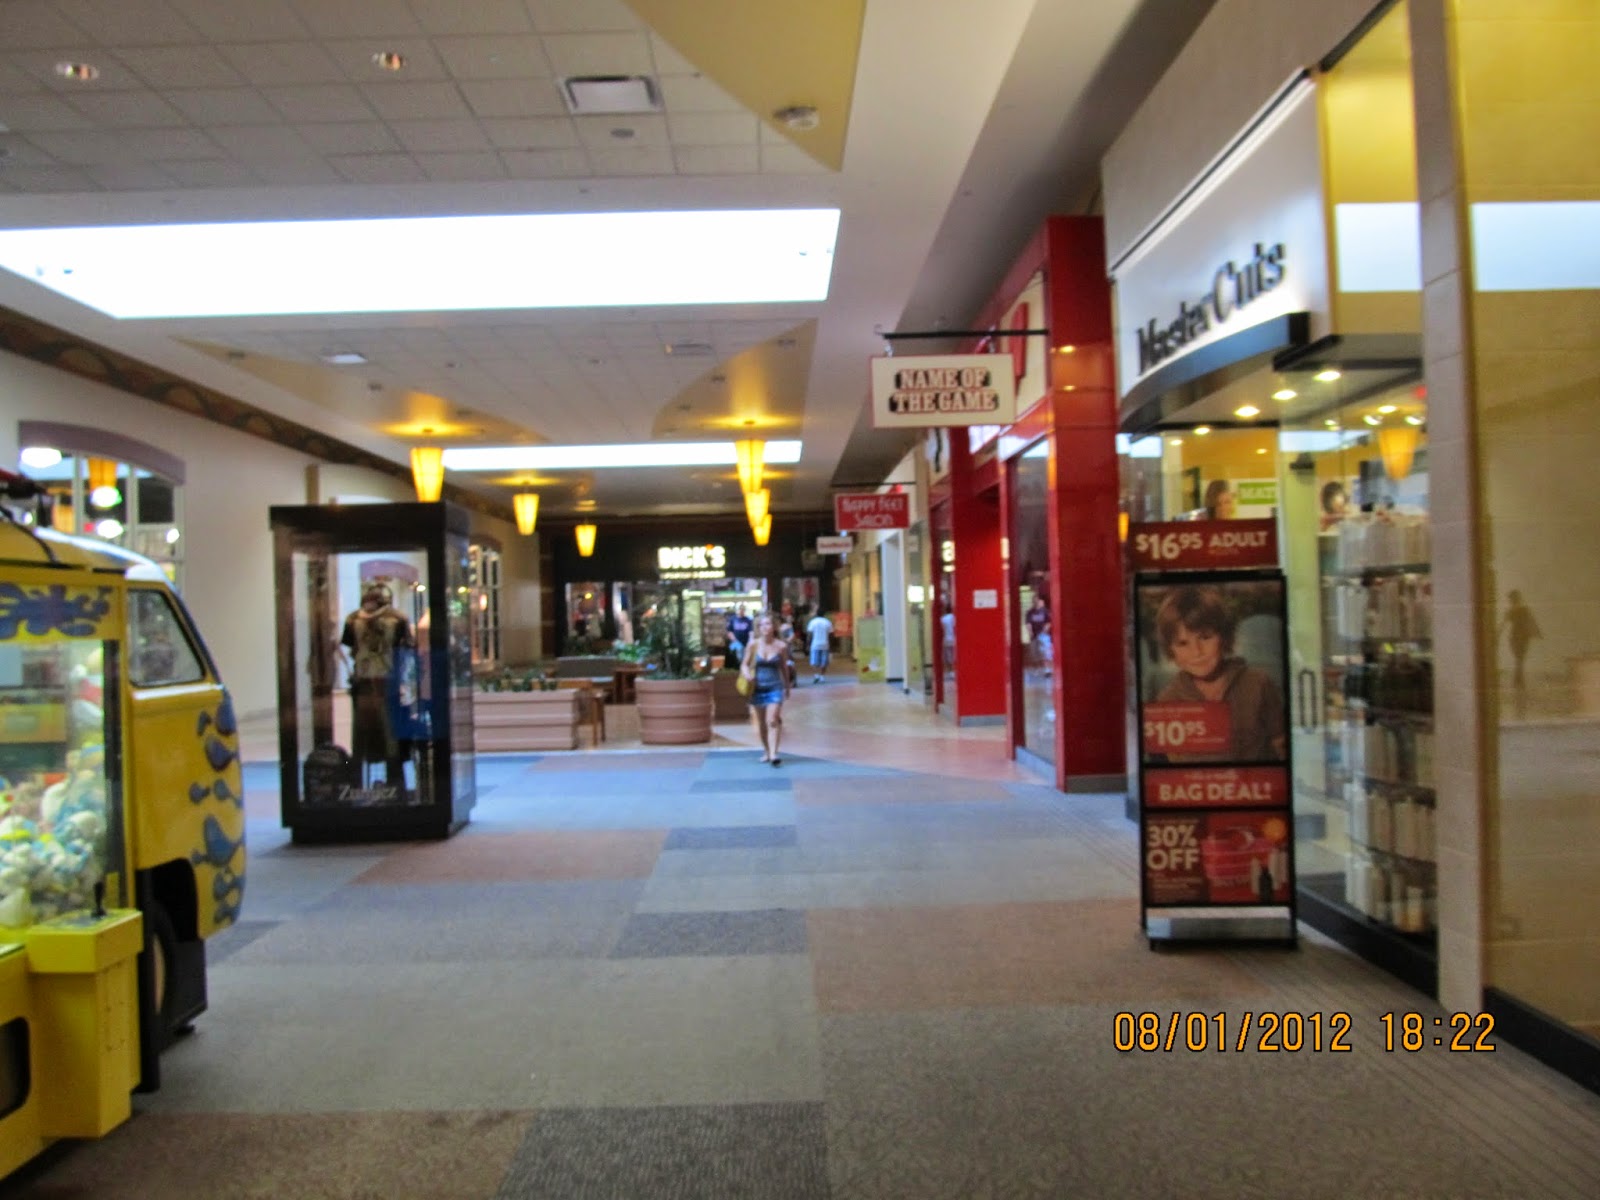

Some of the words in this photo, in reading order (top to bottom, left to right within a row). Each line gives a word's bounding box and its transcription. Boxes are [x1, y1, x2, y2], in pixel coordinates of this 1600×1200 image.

[896, 368, 958, 390] NAME
[960, 366, 990, 388] OF
[890, 392, 937, 413] THE
[938, 389, 998, 412] GAME
[1209, 531, 1268, 547] ADULT
[658, 545, 725, 569] DICK'S
[1159, 783, 1203, 801] BAG
[1207, 781, 1272, 801] DEAL!
[1147, 824, 1198, 848] 30%
[1147, 848, 1199, 871] OFF
